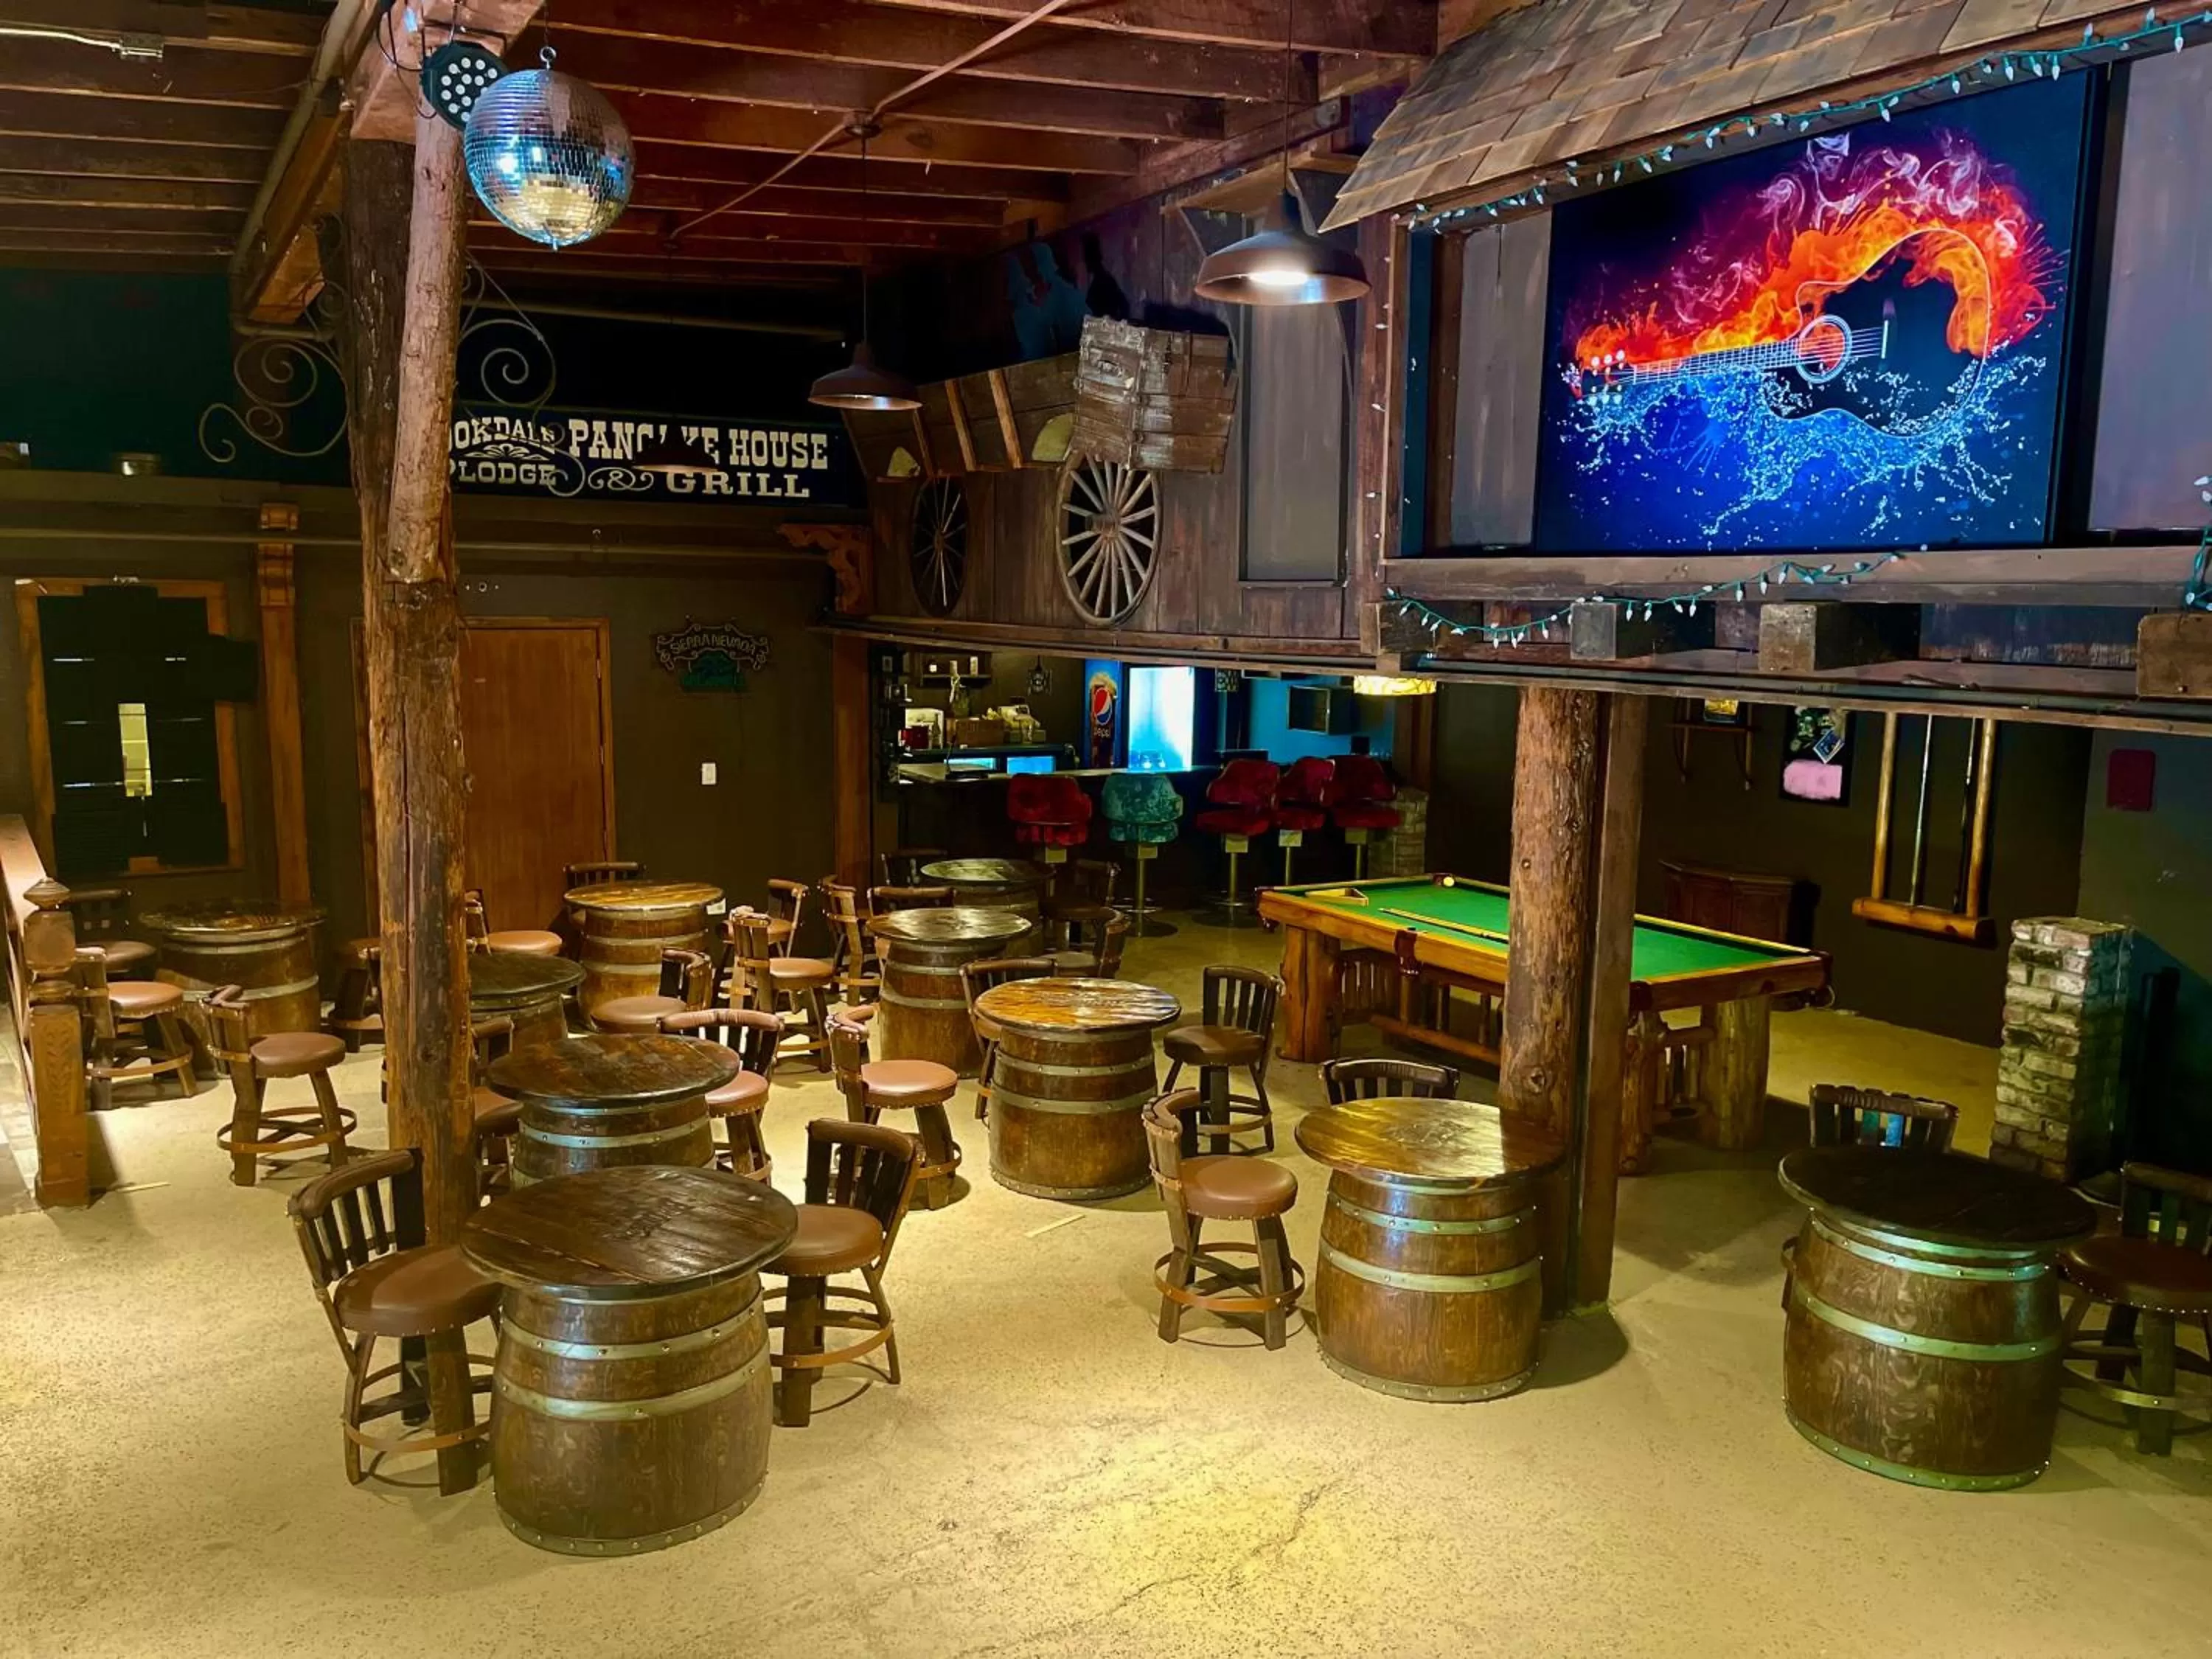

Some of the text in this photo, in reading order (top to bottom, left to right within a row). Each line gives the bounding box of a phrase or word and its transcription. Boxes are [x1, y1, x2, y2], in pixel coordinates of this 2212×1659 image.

[449, 416, 555, 454] OKDALE
[568, 418, 828, 470] PANCE HOUSE
[458, 460, 557, 486] LODGE
[666, 470, 810, 497] GRILL
[712, 633, 756, 655] NEVADA
